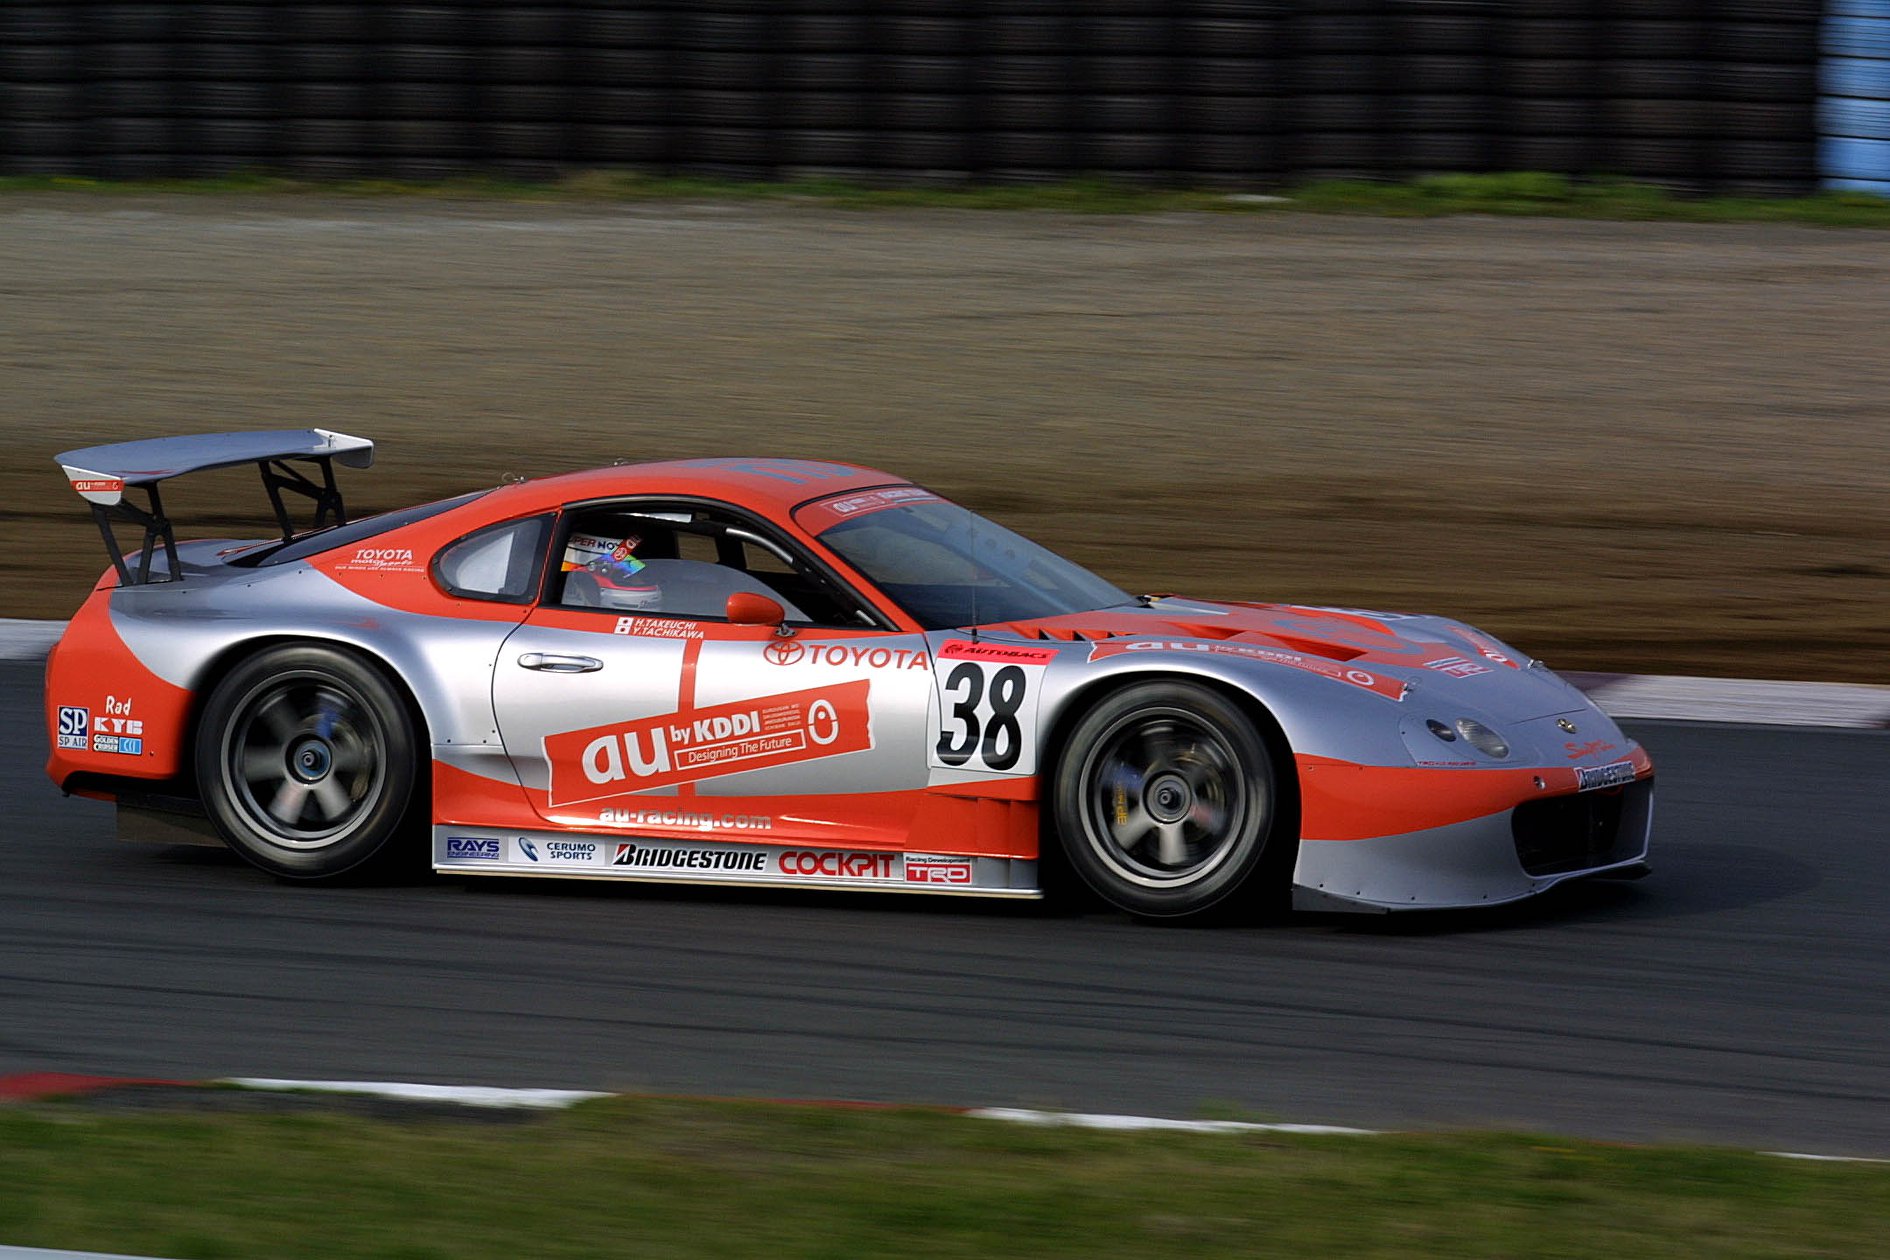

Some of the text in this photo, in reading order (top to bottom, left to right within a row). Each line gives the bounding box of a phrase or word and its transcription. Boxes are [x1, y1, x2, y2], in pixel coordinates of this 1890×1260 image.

[356, 549, 413, 560] TOYOTA
[633, 627, 705, 639] Y.TACHIKAWA
[635, 618, 697, 630] H.TAKEUCHI
[809, 644, 929, 671] TOYOTA
[106, 695, 131, 716] Rad
[60, 707, 88, 735] SP
[94, 717, 143, 735] KYB
[936, 662, 1027, 771] 38
[59, 736, 70, 746] SP
[582, 727, 671, 785] au
[670, 725, 691, 745] by
[693, 710, 761, 743] KDDI
[688, 737, 792, 763] Designing The Future
[599, 807, 772, 832] au-racing.com
[448, 840, 499, 852] RAYS
[547, 842, 596, 852] CERUMO
[550, 850, 593, 860] SPORTS
[613, 843, 767, 871] BRIDGESTONE
[779, 851, 895, 878] COCKPIT
[908, 866, 968, 883] TRD
